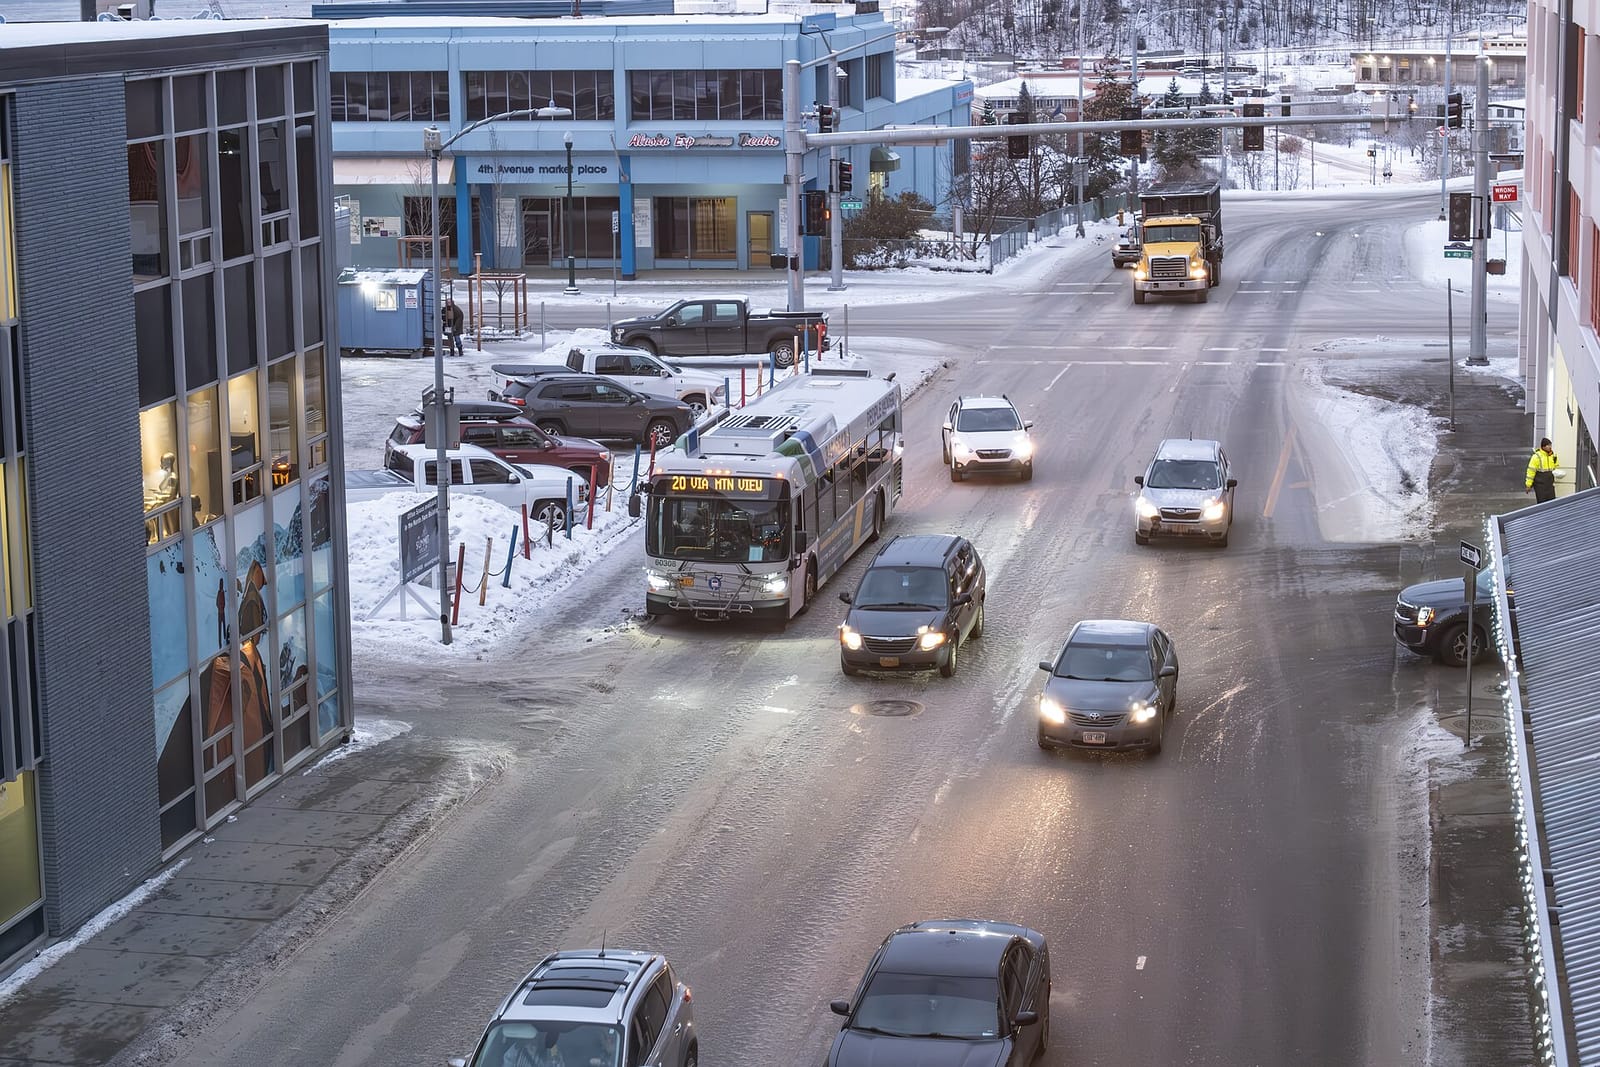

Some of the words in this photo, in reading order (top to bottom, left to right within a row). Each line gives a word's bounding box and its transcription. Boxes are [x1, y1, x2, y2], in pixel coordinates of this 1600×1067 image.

[628, 133, 671, 147] Alaska
[478, 164, 493, 174] 4th
[498, 165, 534, 174] Avenue
[578, 164, 607, 175] place
[672, 476, 687, 490] 20
[690, 477, 709, 490] VIA
[714, 478, 734, 491] MTN
[738, 479, 763, 492] VIEW
